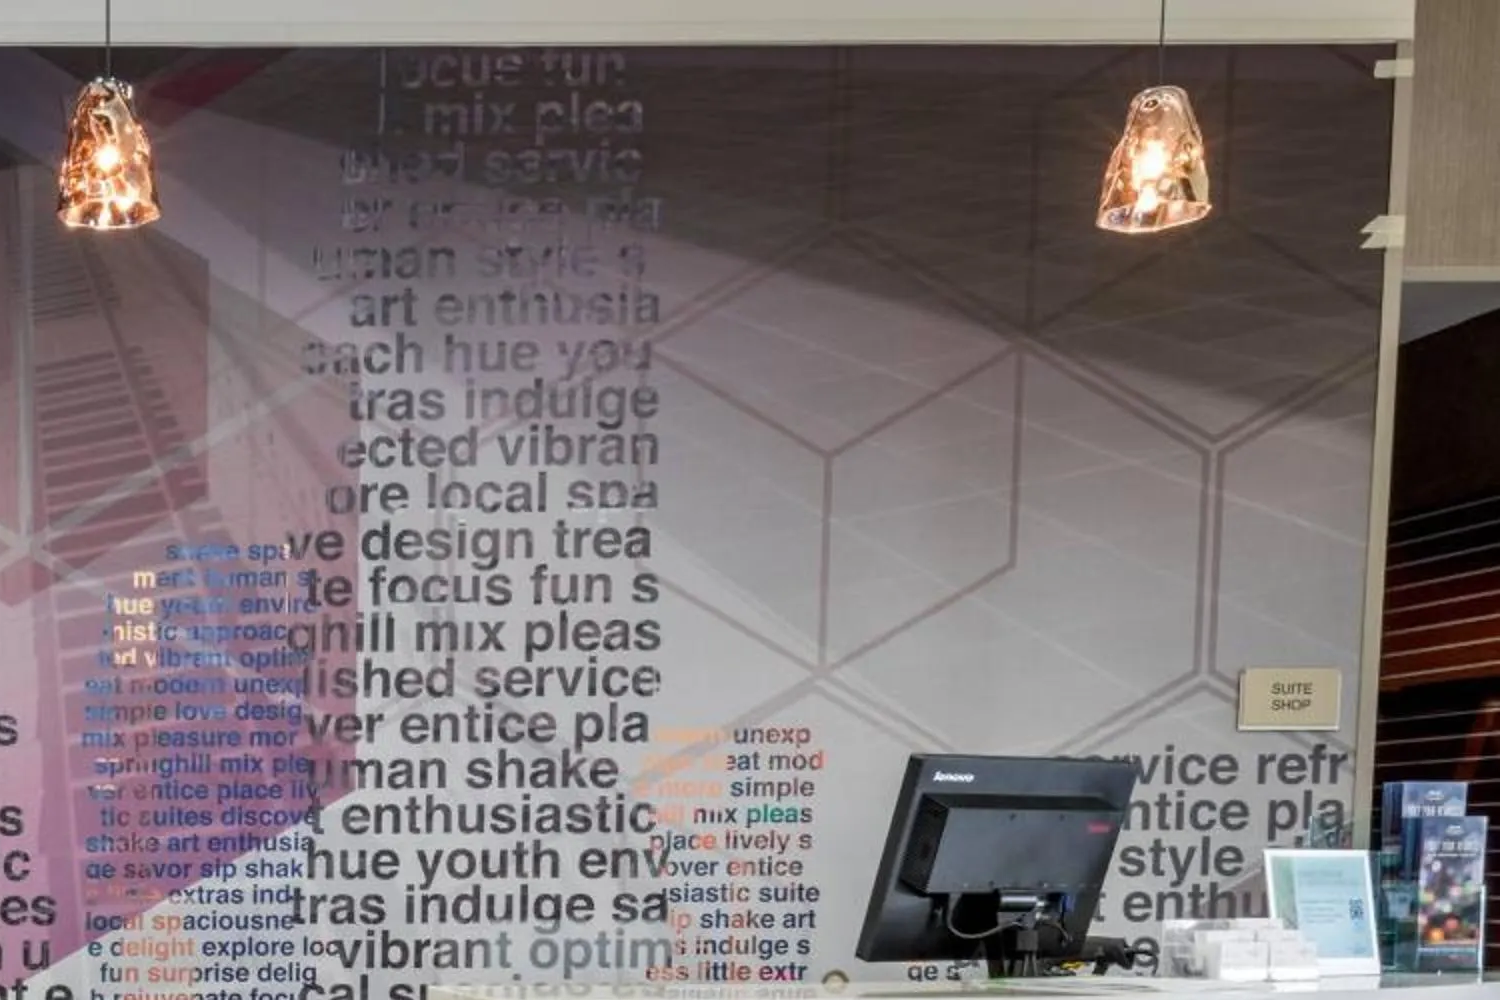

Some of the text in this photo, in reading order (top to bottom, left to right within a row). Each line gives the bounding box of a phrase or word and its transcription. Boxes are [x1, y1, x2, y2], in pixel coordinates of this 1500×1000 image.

[424, 92, 516, 135] mix
[351, 287, 417, 327] art
[444, 333, 539, 375] hue
[465, 378, 660, 429] indulge
[498, 425, 659, 467] vibran
[428, 472, 547, 513] local
[287, 521, 651, 571] ve design trea
[370, 566, 512, 606] focus
[531, 564, 612, 605] fun
[633, 573, 660, 605] s
[416, 619, 504, 652] mix
[525, 611, 661, 662] pleas
[475, 656, 661, 698] service
[1271, 682, 1313, 695] SUITE
[1271, 699, 1312, 712] SHOP
[135, 727, 242, 752] pleasure
[251, 729, 297, 748] mor
[306, 712, 384, 744] ver
[401, 703, 556, 744] entice
[575, 703, 649, 753] pla
[734, 725, 811, 748] unexp
[220, 754, 263, 774] mix
[466, 749, 618, 789] shake
[769, 751, 824, 771] mod
[1257, 744, 1349, 784] refr
[217, 781, 284, 805] place
[731, 777, 815, 801] simple
[221, 806, 316, 826] discove
[342, 794, 656, 835] enthusiastic
[747, 804, 813, 829] pleas
[168, 833, 199, 852] art
[207, 831, 311, 852] enthusia
[651, 830, 812, 856] place lively s
[201, 859, 237, 886] sip
[245, 857, 303, 880] shak
[307, 837, 669, 890] hue youth env
[727, 856, 803, 877] entice
[1118, 836, 1244, 888] style
[760, 884, 820, 902] suite
[152, 912, 294, 935] spaciousne
[292, 885, 668, 935] tras indulge sa
[700, 909, 775, 929] shake
[783, 910, 816, 929] art
[23, 941, 51, 971] u
[88, 939, 102, 957] e
[111, 937, 196, 961] delight
[202, 937, 294, 961] explore
[335, 930, 673, 978] vibrant optim
[696, 936, 811, 960] indulge s
[100, 962, 317, 988] fun surprise delig
[698, 962, 752, 981] little
[759, 963, 808, 981] extr
